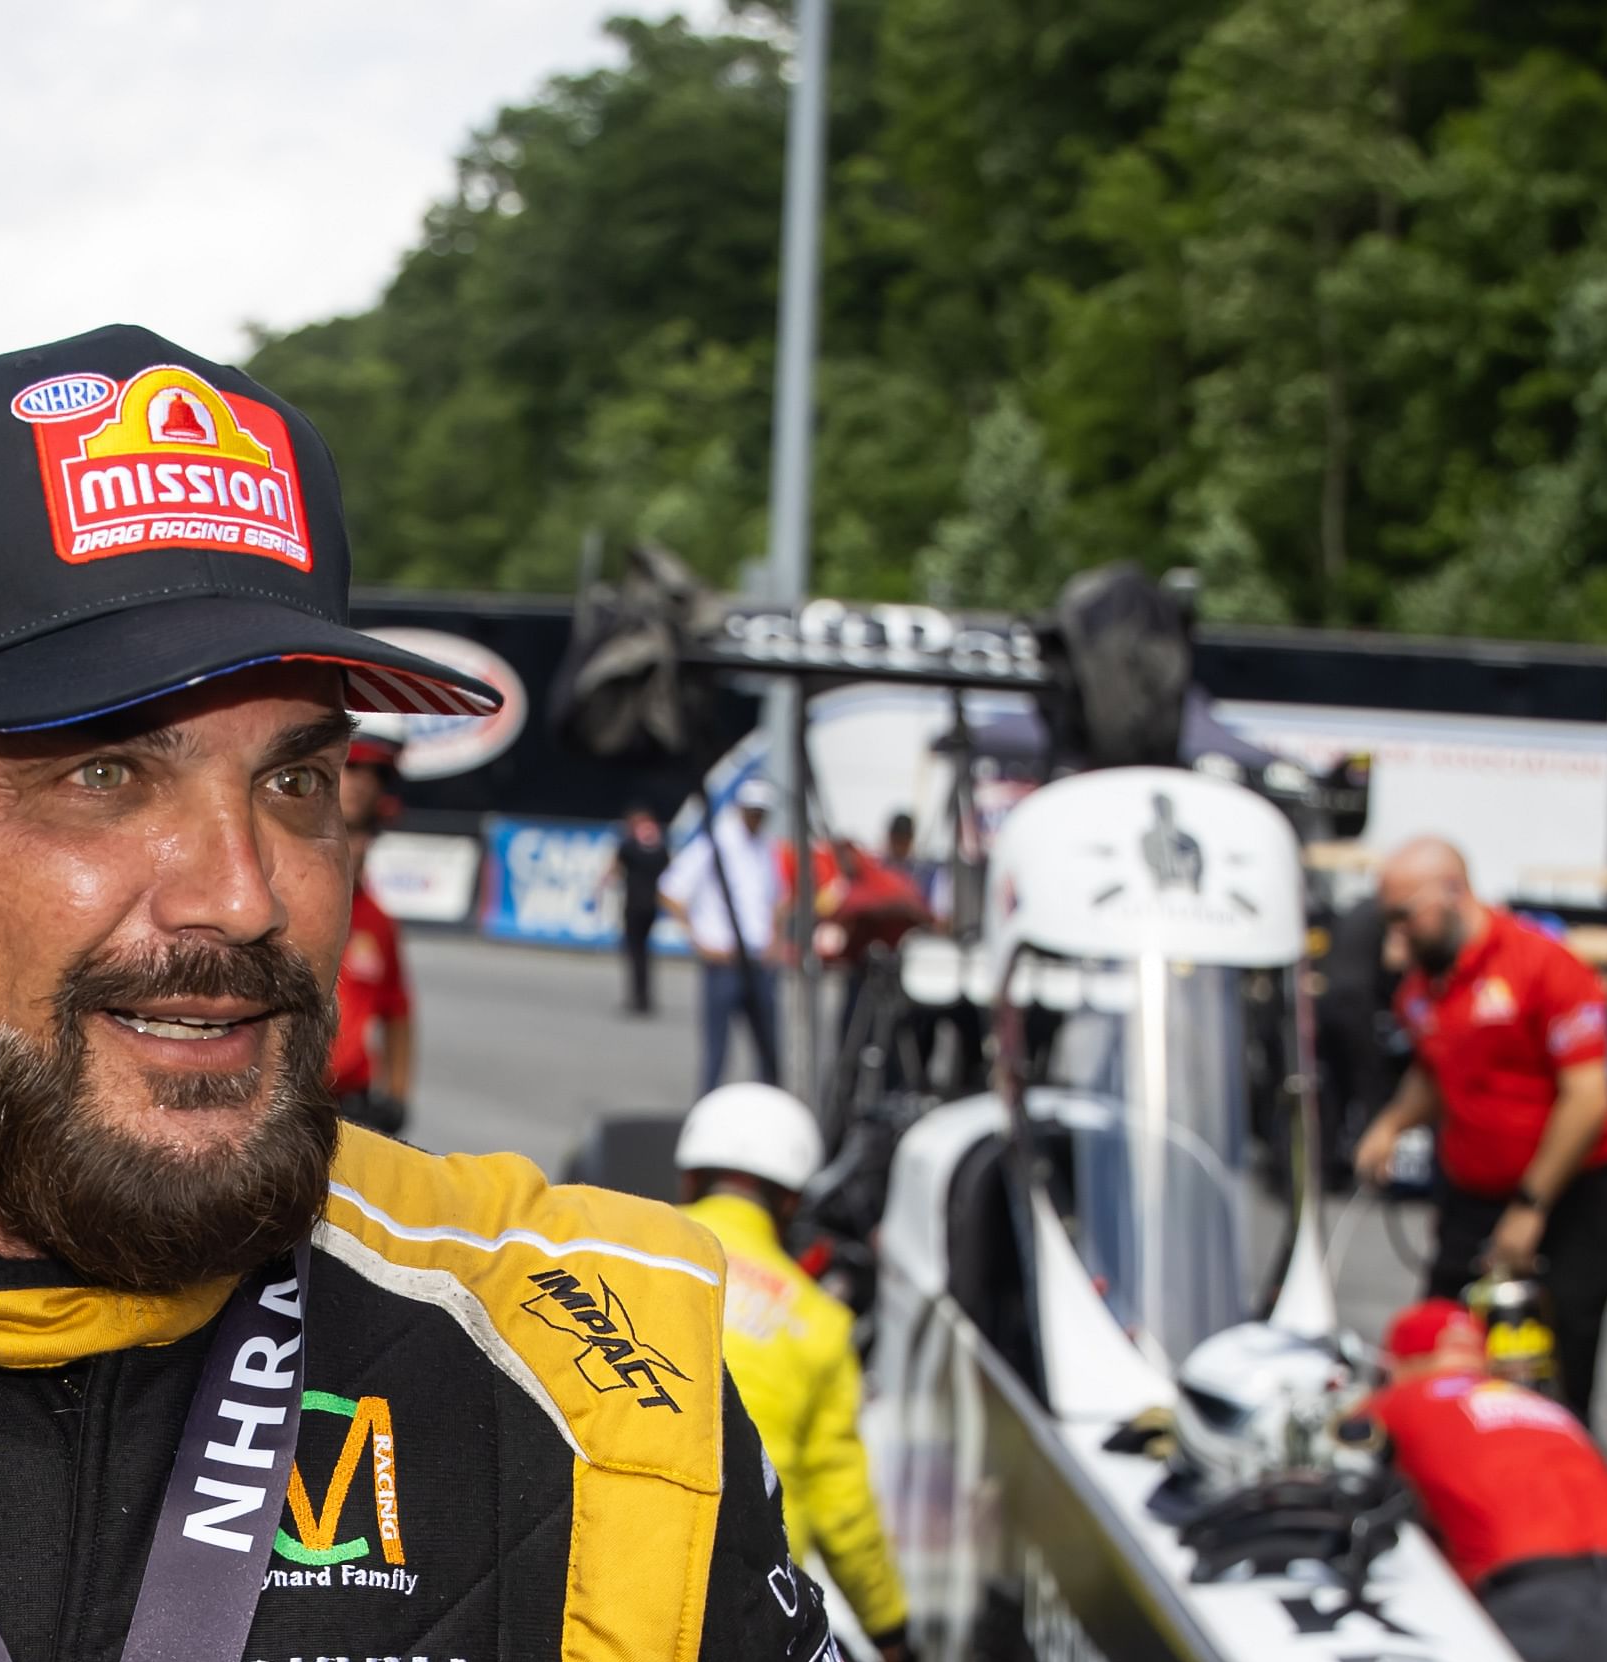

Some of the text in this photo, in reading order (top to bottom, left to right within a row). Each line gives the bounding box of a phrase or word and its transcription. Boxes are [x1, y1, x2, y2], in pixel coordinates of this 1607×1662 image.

[25, 381, 107, 412] NHRA
[72, 521, 307, 562] DRAG RACING SERIES
[528, 1269, 684, 1414] IMPACT
[183, 1276, 304, 1552] NHRA
[373, 1433, 398, 1540] RACING
[261, 1564, 419, 1596] ynard Family
